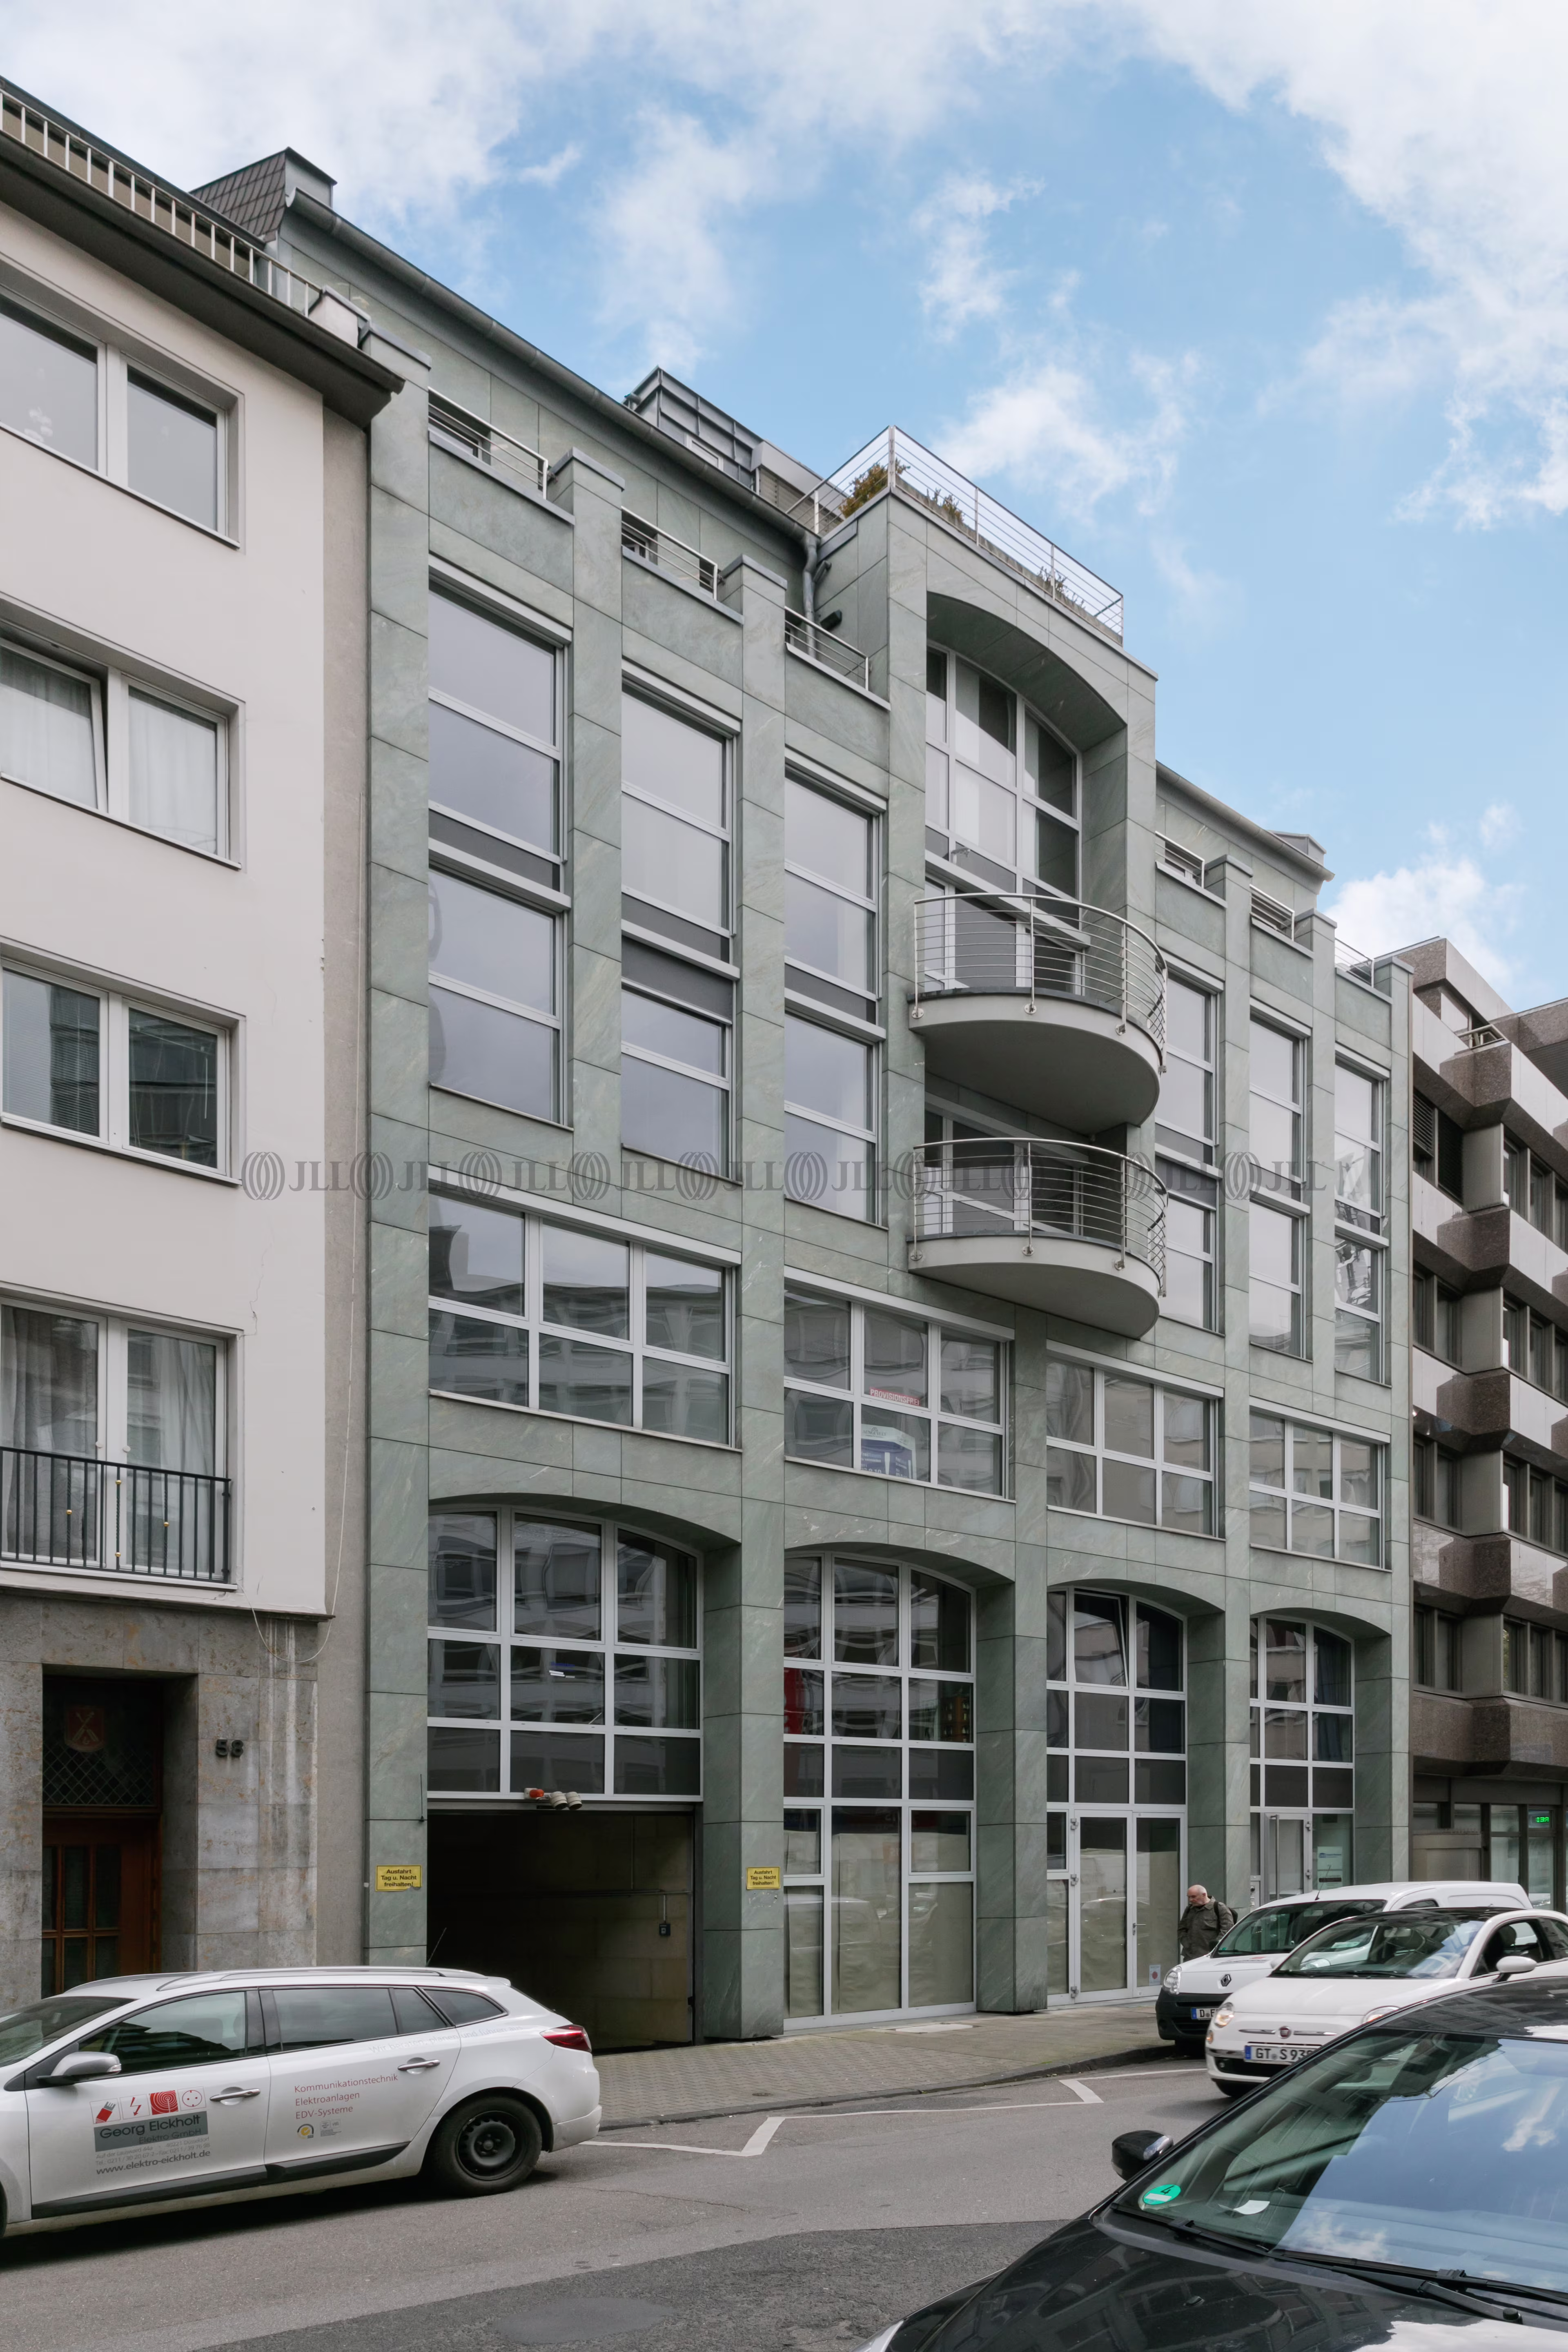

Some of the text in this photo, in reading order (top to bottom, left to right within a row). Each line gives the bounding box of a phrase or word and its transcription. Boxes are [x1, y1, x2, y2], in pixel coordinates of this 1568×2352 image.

[870, 1389, 920, 1406] PROVISIONSFREI
[216, 1740, 244, 1758] 58
[368, 2045, 386, 2053] Wir
[429, 2035, 459, 2045] planen
[1256, 2048, 1271, 2059] GT
[1279, 2049, 1287, 2060] S
[294, 2074, 398, 2092] Kommunikationstechnik
[296, 2092, 360, 2106] Elektroanlagen
[296, 2106, 353, 2119] EDV-Systeme
[100, 2115, 201, 2138] Georg Eickholt
[139, 2129, 201, 2144] Elektro GmbH
[96, 2150, 211, 2175] www.elektro-eickholt.de
[1160, 2185, 1175, 2195] 4
